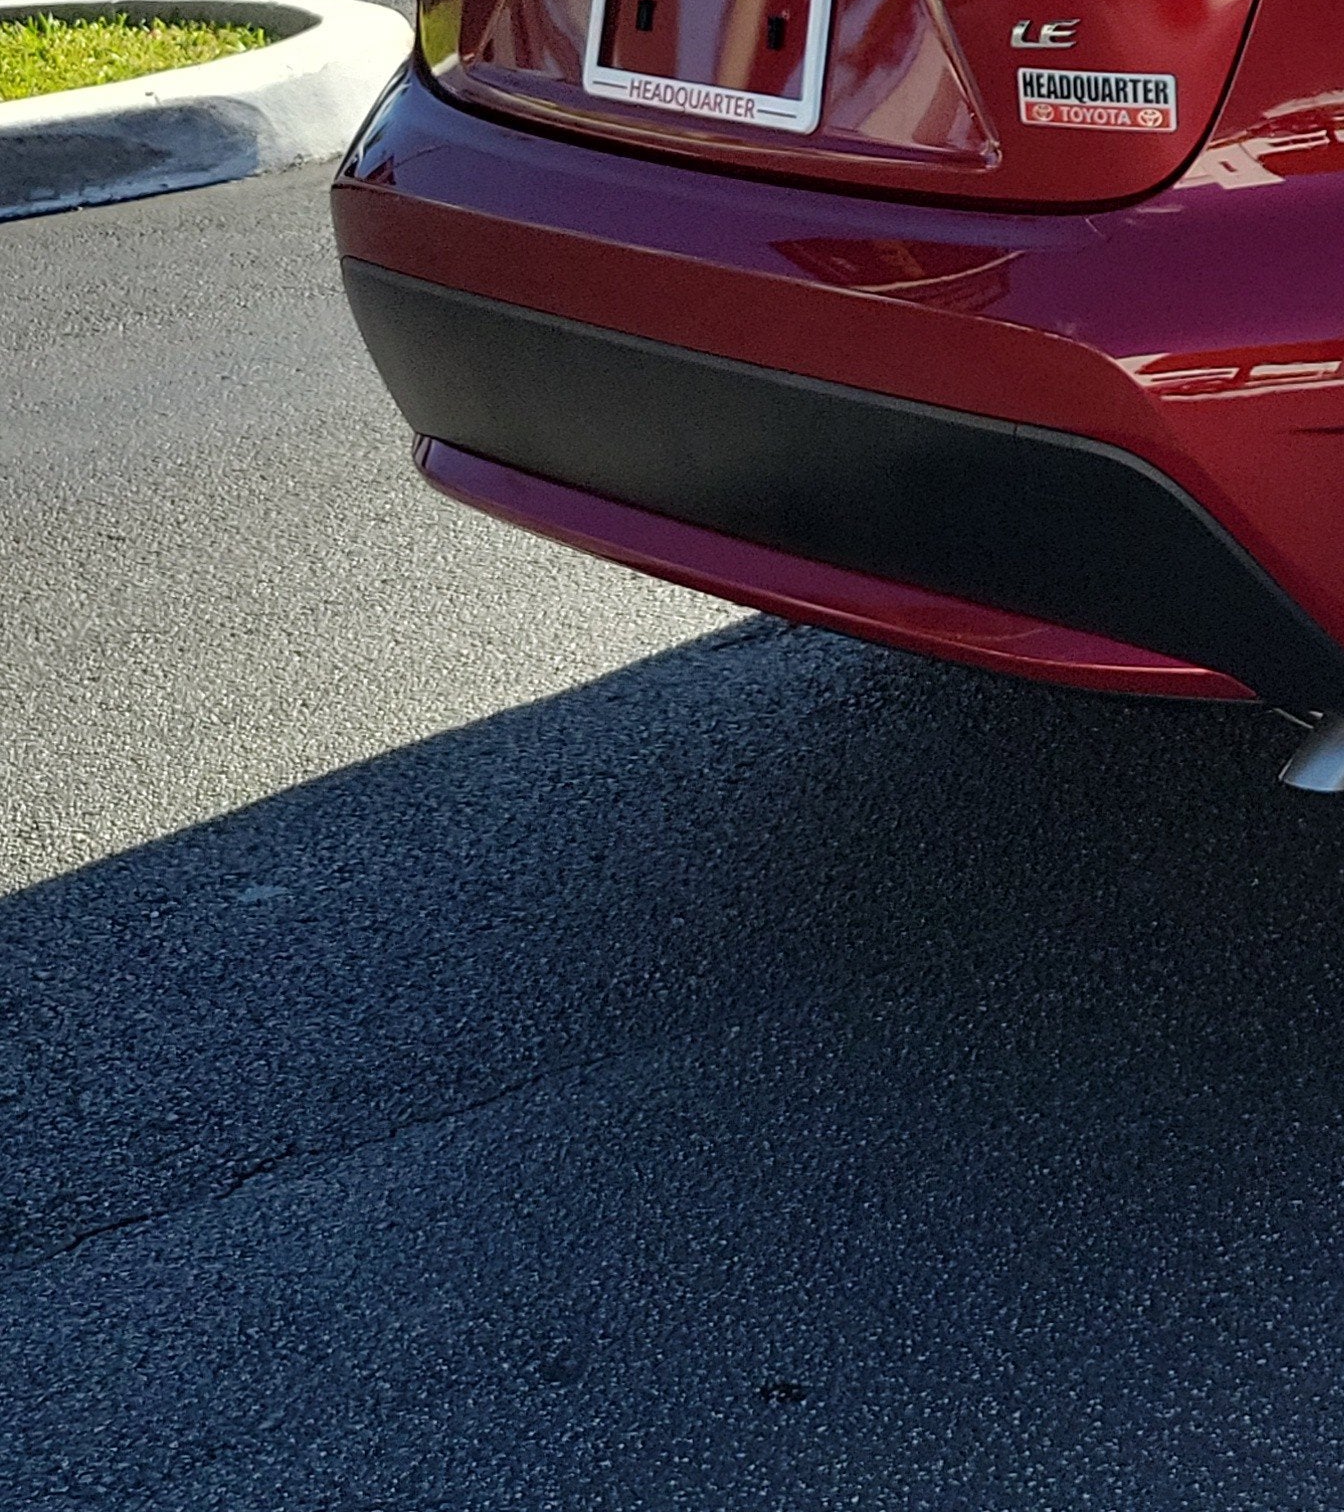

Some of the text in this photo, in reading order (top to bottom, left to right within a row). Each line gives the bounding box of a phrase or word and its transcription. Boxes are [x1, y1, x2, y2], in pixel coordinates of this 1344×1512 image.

[1011, 19, 1081, 48] LE
[629, 78, 755, 119] HEADQUARTER
[1022, 72, 1169, 105] HEADQUARTER
[1060, 106, 1132, 125] TOYOTA
